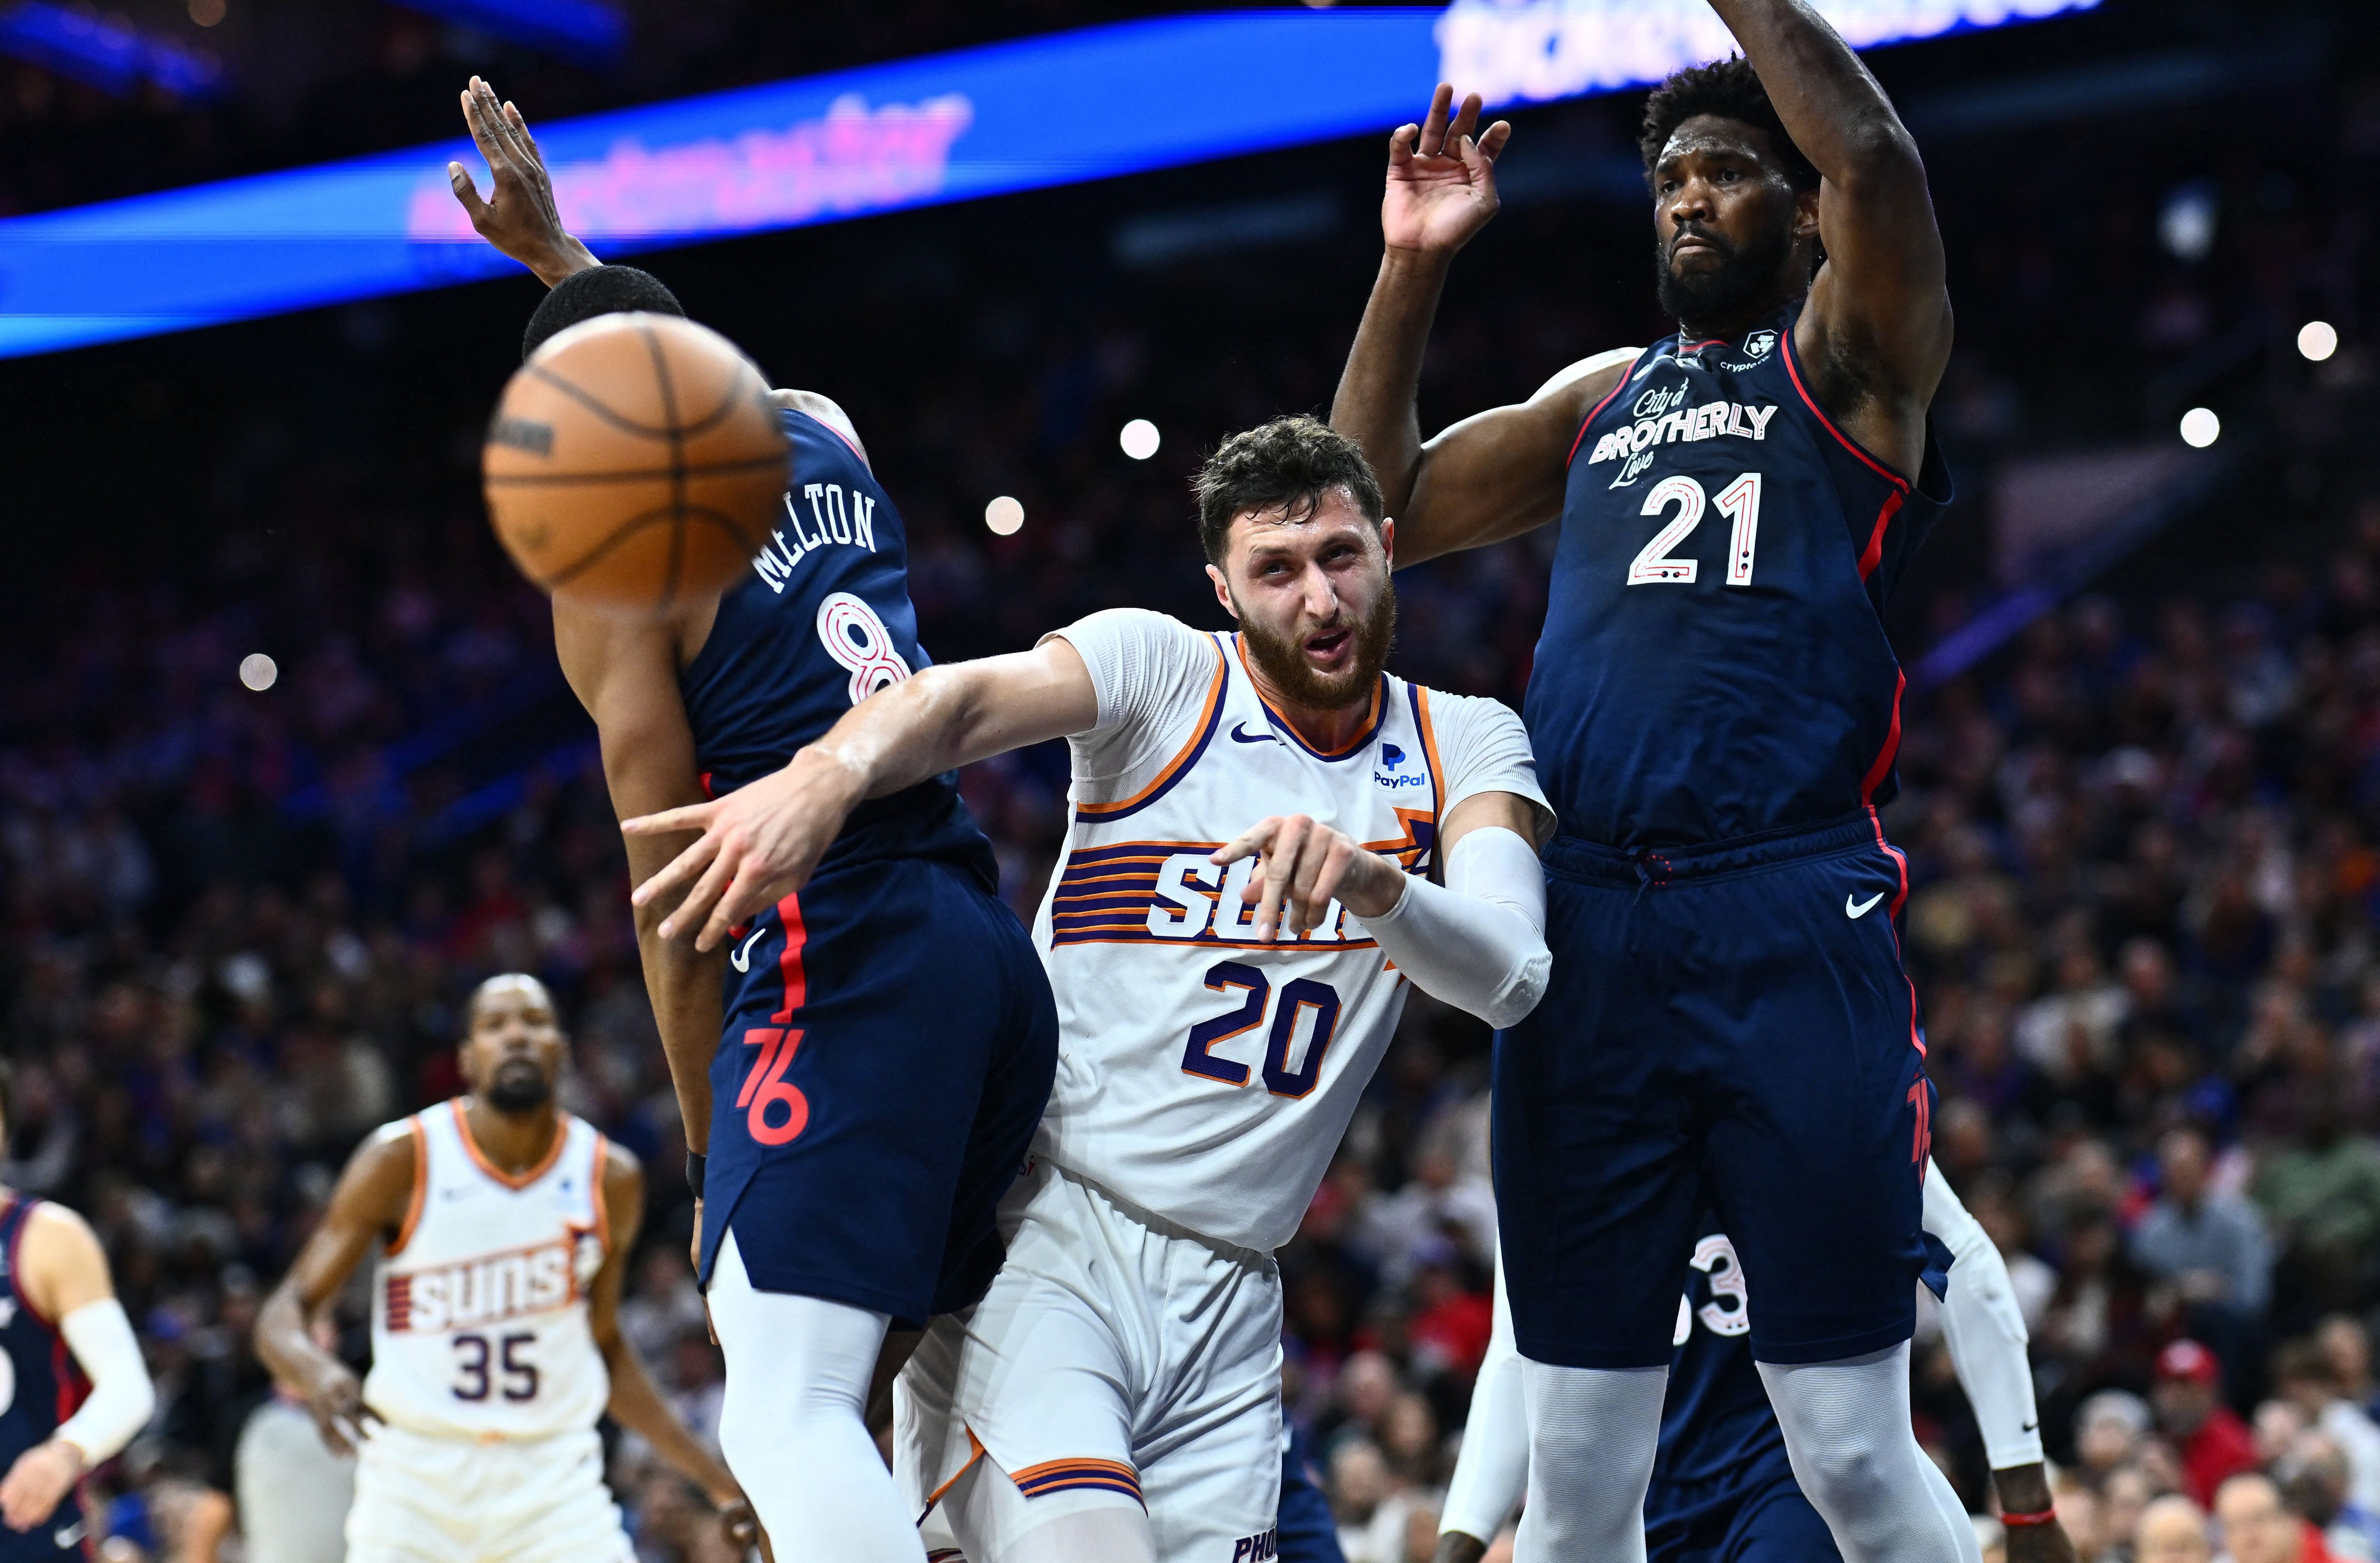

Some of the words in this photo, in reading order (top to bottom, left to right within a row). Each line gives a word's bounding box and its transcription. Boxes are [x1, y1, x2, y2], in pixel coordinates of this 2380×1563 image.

[1588, 401, 1778, 464] BROTHERLY
[1633, 386, 1667, 426] City
[1671, 377, 1689, 406] of
[1609, 451, 1654, 489] Love
[752, 483, 875, 594] MELTON
[1627, 472, 1761, 586] 21
[1375, 771, 1424, 788] PayPal
[1146, 854, 1373, 941] SU
[1181, 961, 1341, 1100] 20
[736, 1028, 809, 1146] 76
[1673, 1234, 1750, 1345] 3
[452, 1332, 539, 1402] 35
[1232, 1527, 1277, 1563] PHO
